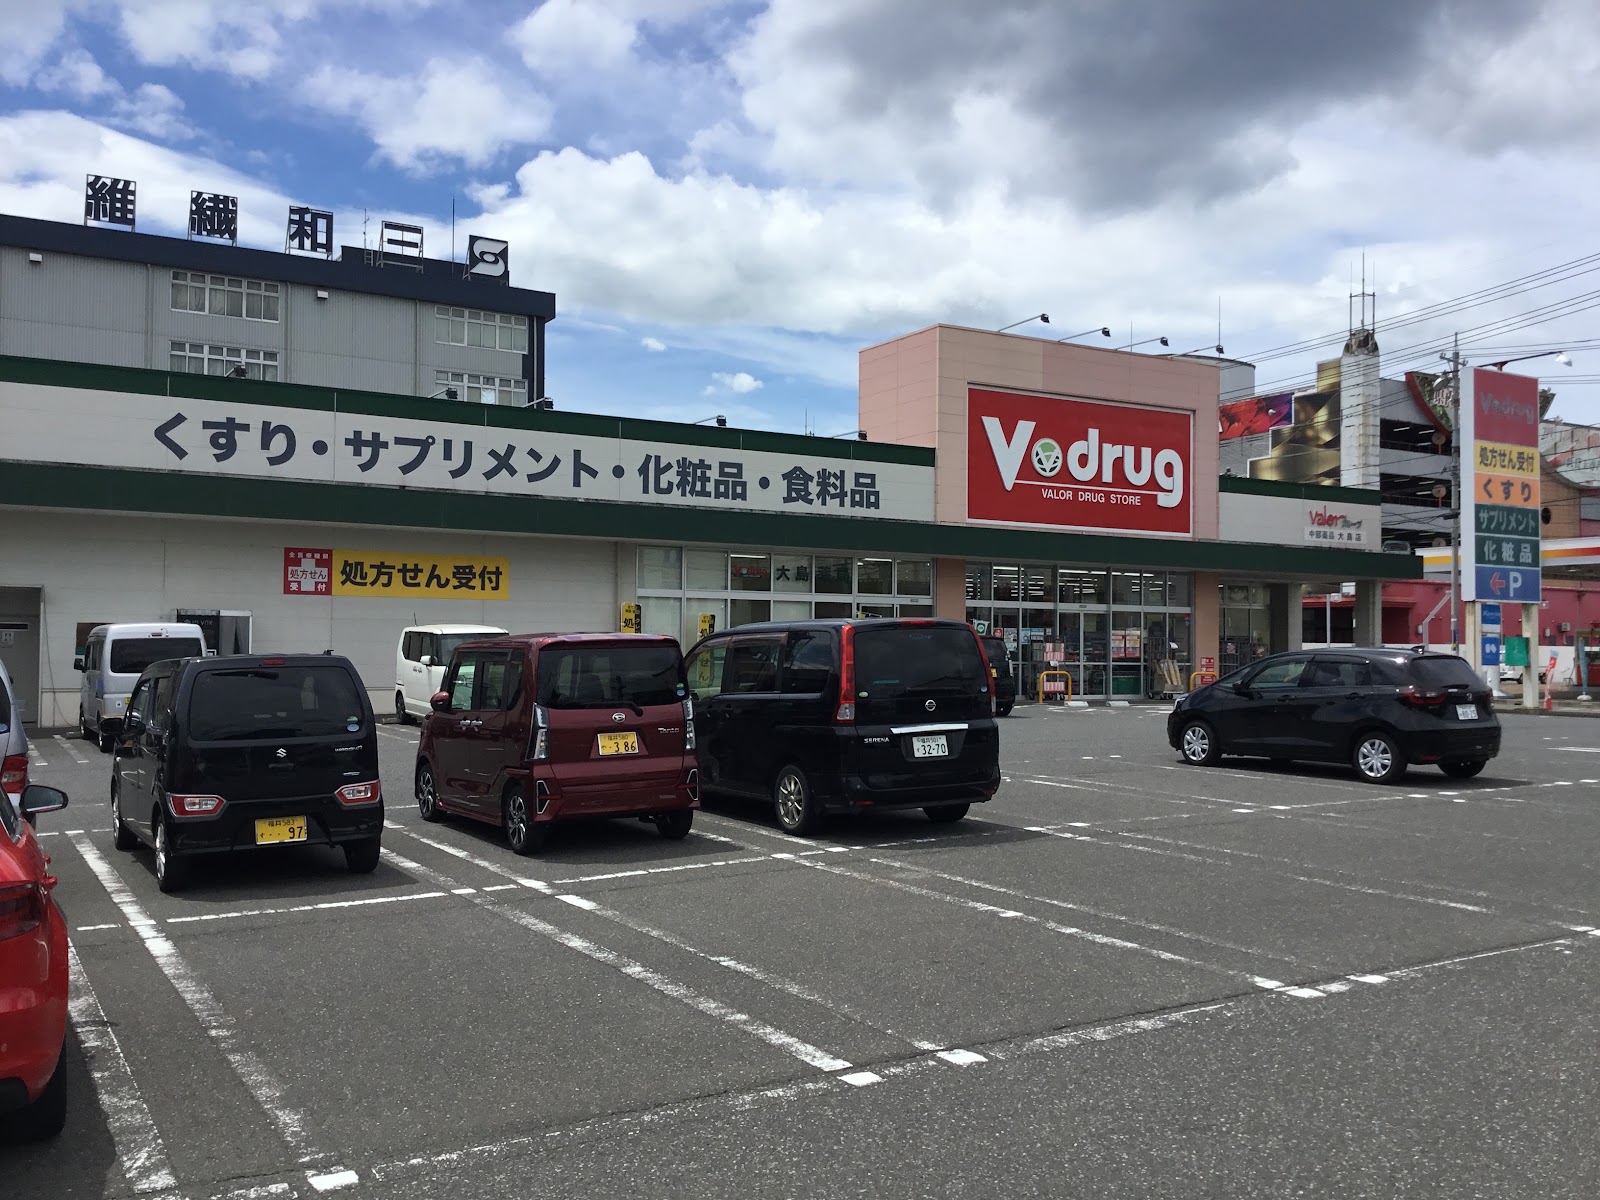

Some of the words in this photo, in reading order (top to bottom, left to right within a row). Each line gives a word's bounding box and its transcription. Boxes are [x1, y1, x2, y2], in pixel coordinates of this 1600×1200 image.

[1479, 391, 1534, 425] Vodrug
[981, 415, 1184, 508] Vodrug
[1479, 445, 1535, 473] 処方せん受付
[1042, 488, 1073, 501] VALOR
[1078, 491, 1105, 504] DRUG
[1110, 494, 1141, 506] STORE
[1483, 478, 1532, 503] くすり
[1479, 508, 1536, 534] サプリメント
[1337, 532, 1362, 542] 大島店
[1483, 540, 1532, 564] 化粧品
[289, 569, 327, 580] 処方せん
[340, 559, 504, 592] 処方せん受付
[1509, 571, 1522, 597] P
